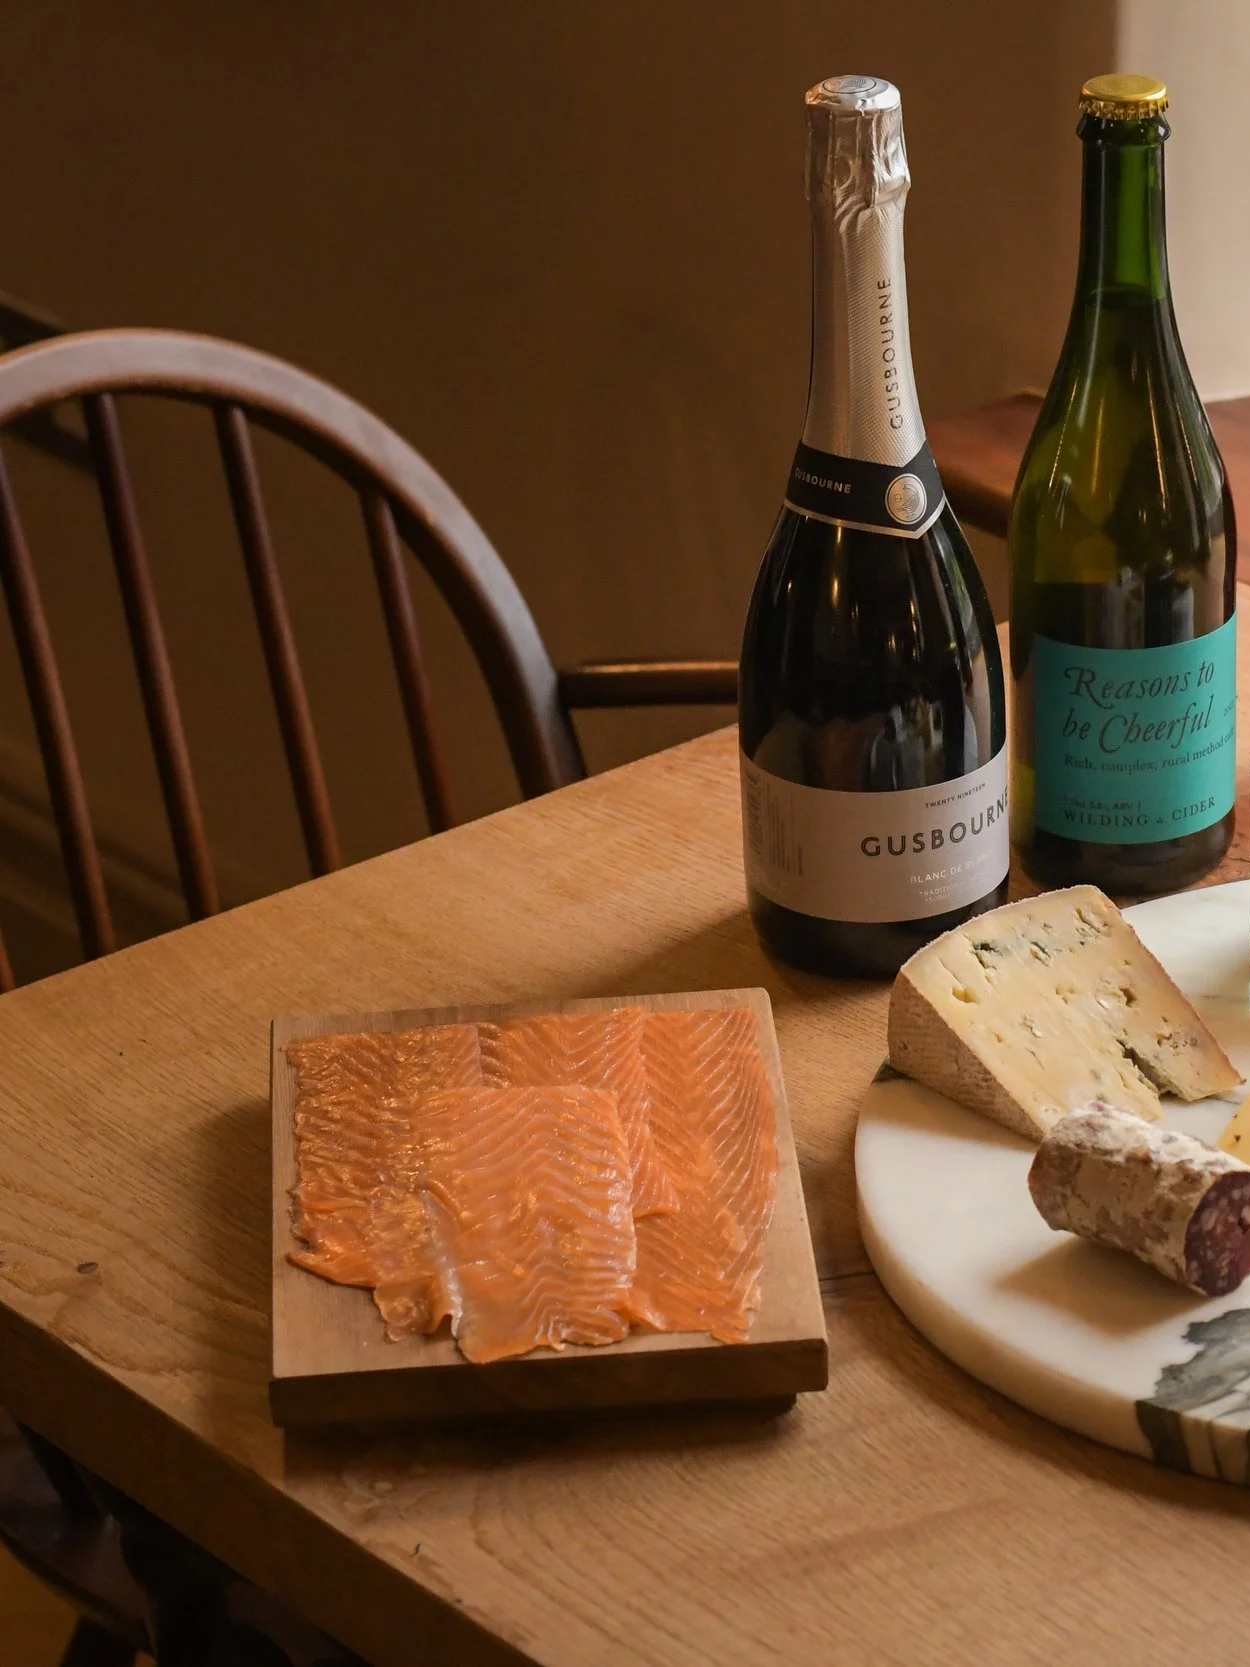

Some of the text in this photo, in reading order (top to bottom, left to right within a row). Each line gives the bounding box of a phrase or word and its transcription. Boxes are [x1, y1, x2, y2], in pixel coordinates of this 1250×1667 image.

[876, 277, 905, 430] GUSBOURNE
[1064, 666, 1192, 710] Reasons
[1197, 661, 1215, 689] to
[1062, 707, 1092, 741] be
[1099, 694, 1215, 754] Cheerful
[1100, 760, 1158, 776] complex,
[1162, 751, 1190, 769] rural
[1192, 734, 1224, 761] method
[924, 782, 987, 809] TWENTY NINETEEN
[1064, 796, 1215, 827] WILDING CIDER
[910, 869, 947, 885] BLANC
[950, 864, 963, 876] DE
